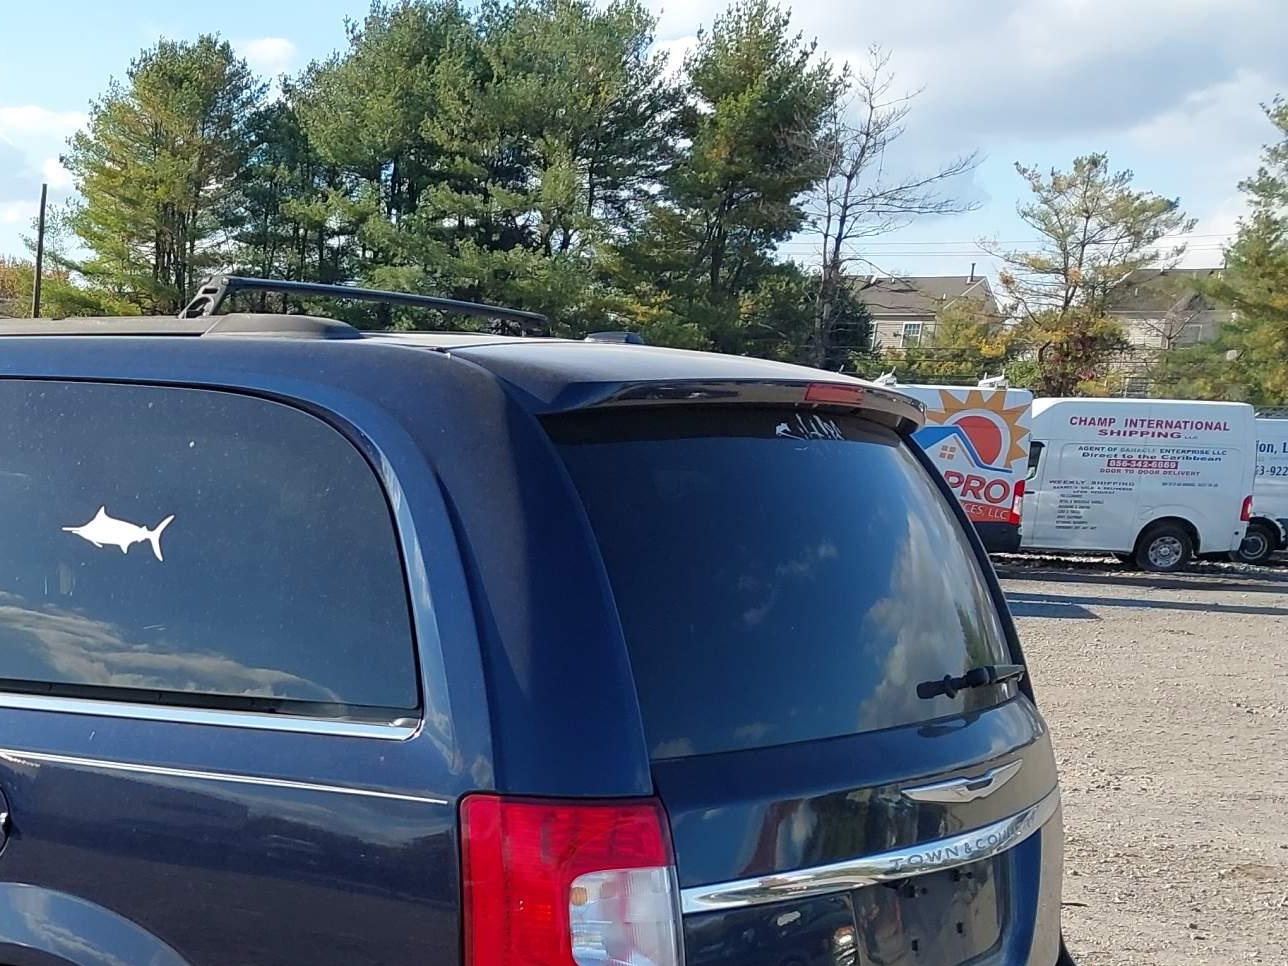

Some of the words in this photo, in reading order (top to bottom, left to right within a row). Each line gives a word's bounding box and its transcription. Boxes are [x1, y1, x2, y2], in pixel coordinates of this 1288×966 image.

[1069, 416, 1116, 427] CHAMP
[1124, 417, 1231, 431] INTERNATIONAL
[1097, 429, 1182, 439] SHIPPING
[988, 507, 1009, 520] LLC
[889, 845, 959, 871] TOWN
